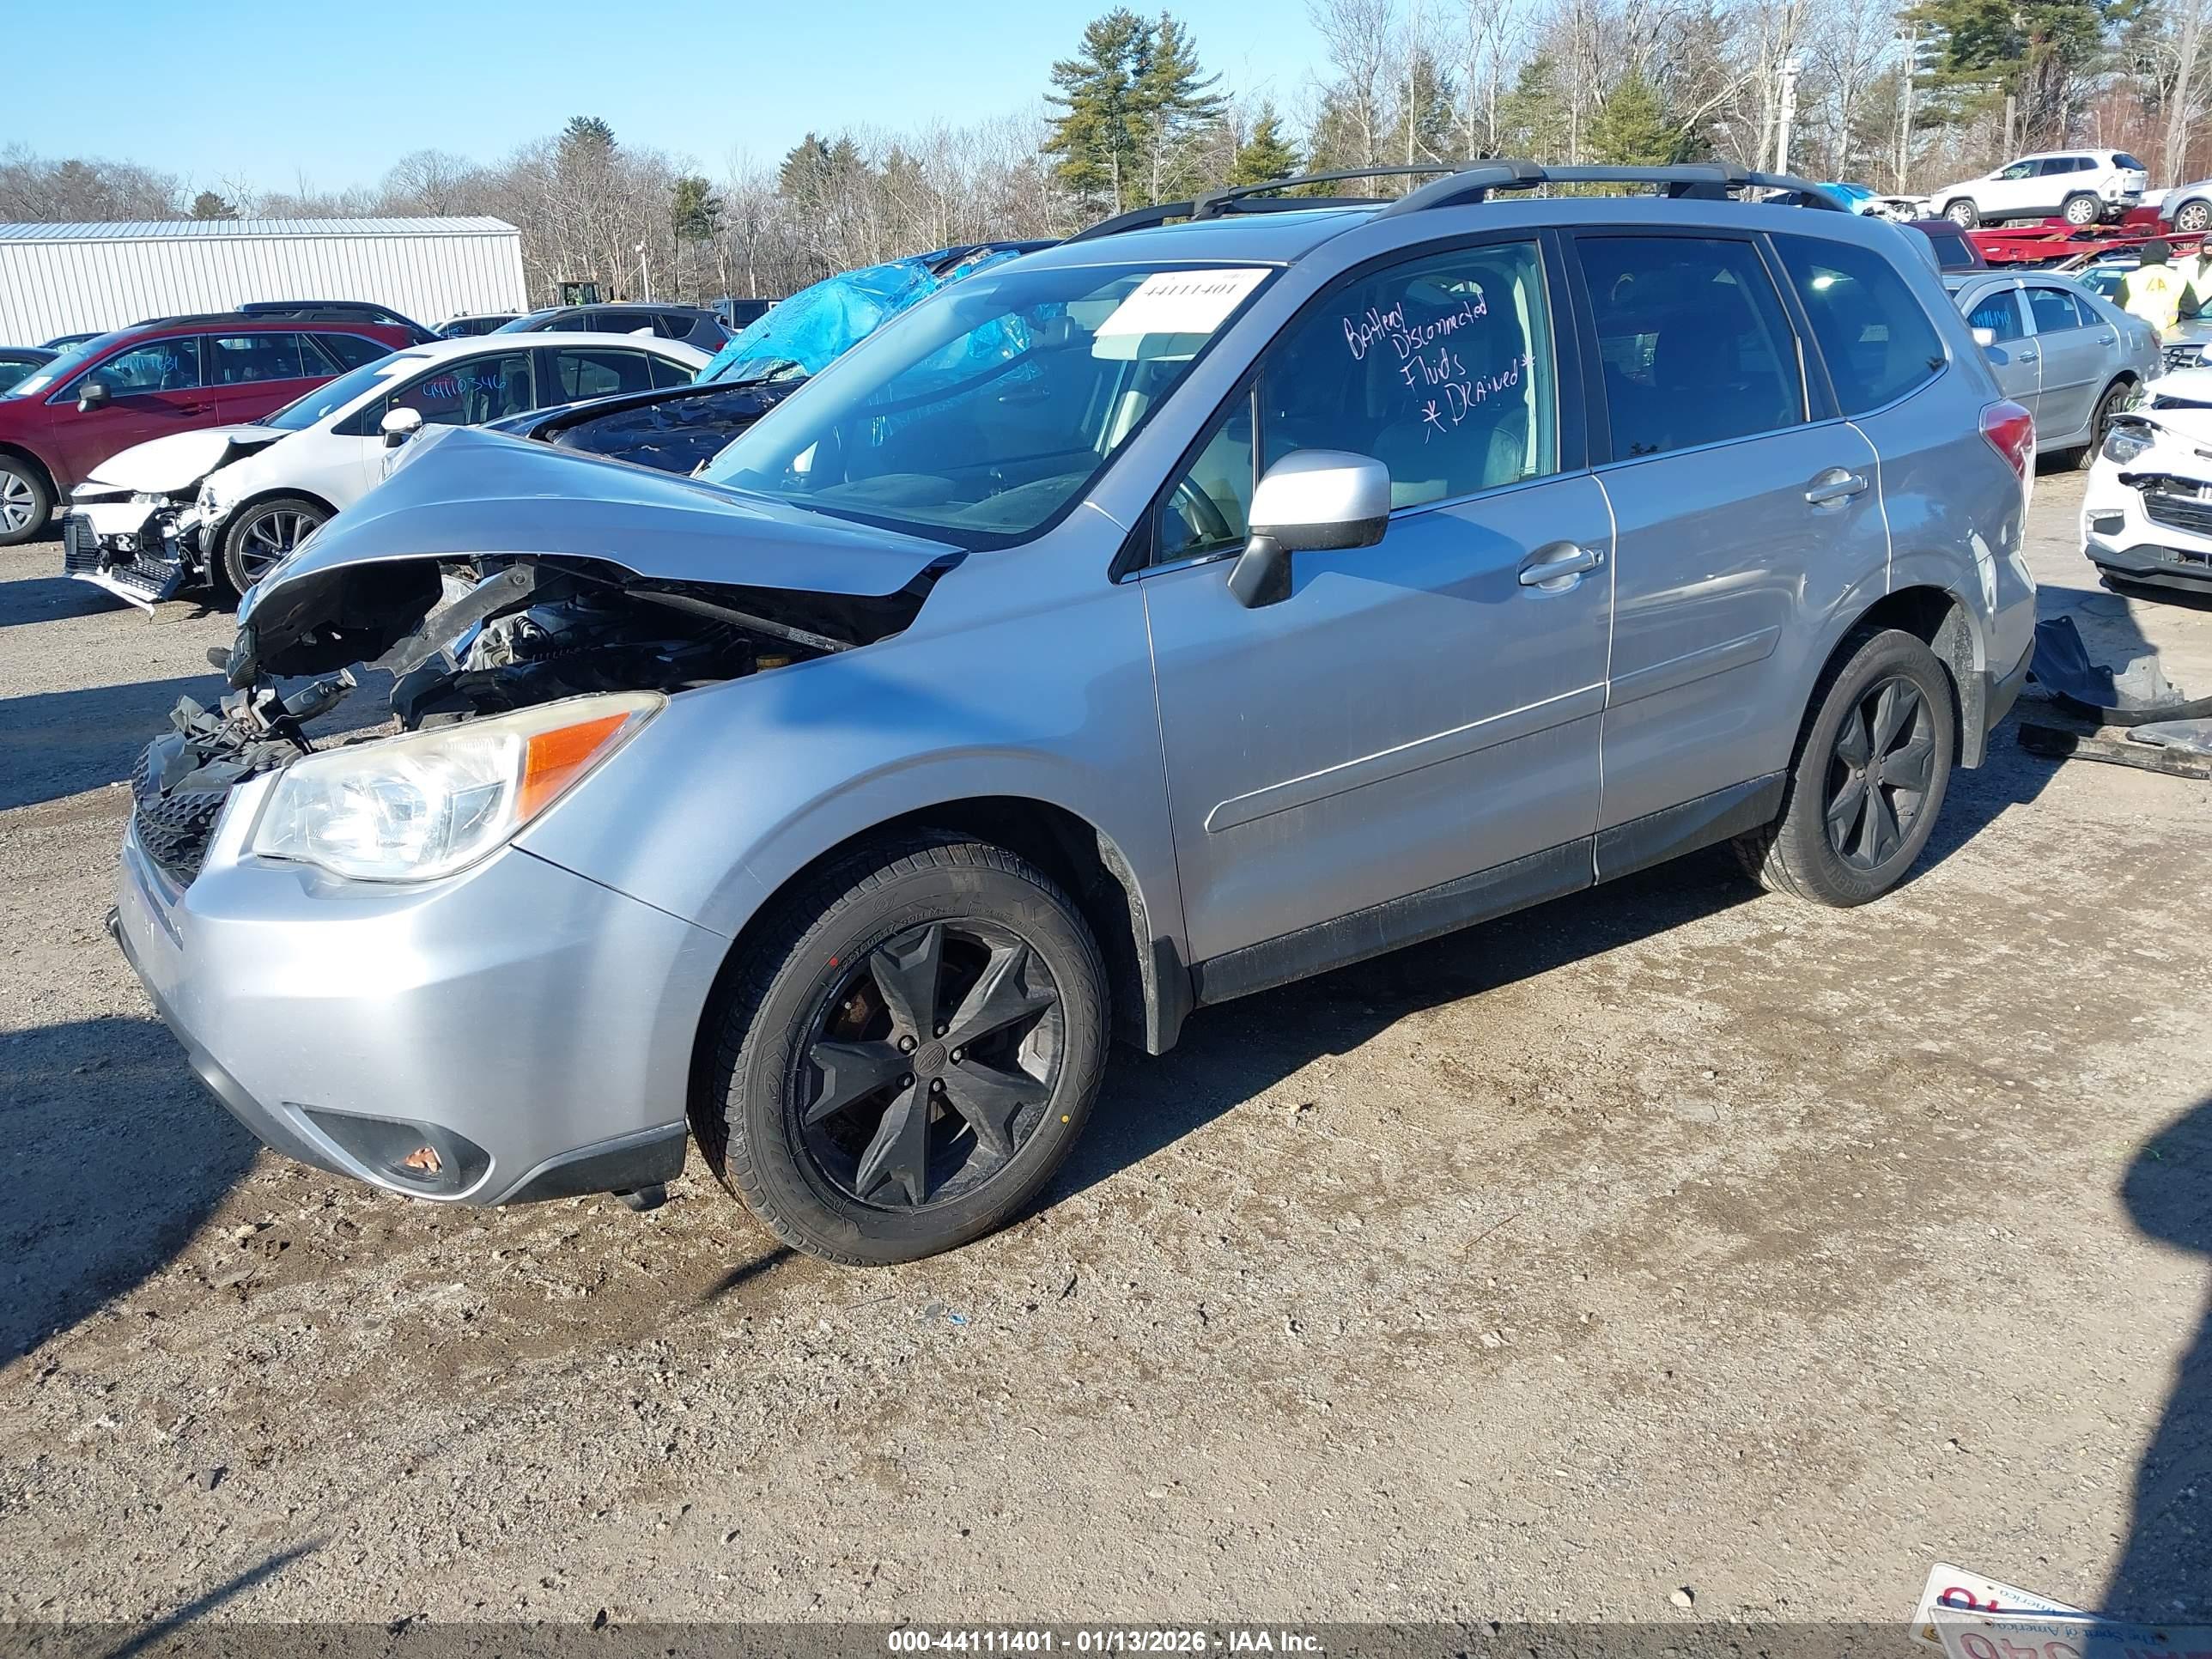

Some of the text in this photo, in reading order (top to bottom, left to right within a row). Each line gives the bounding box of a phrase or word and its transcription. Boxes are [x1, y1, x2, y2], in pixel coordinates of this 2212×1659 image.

[1144, 283, 1237, 296] 44111401
[1399, 347, 1467, 393] Fluids
[422, 374, 507, 398] 44110346
[1996, 1623, 2058, 1636] America
[2063, 1628, 2078, 1639] of
[2085, 1629, 2125, 1643] Spirit
